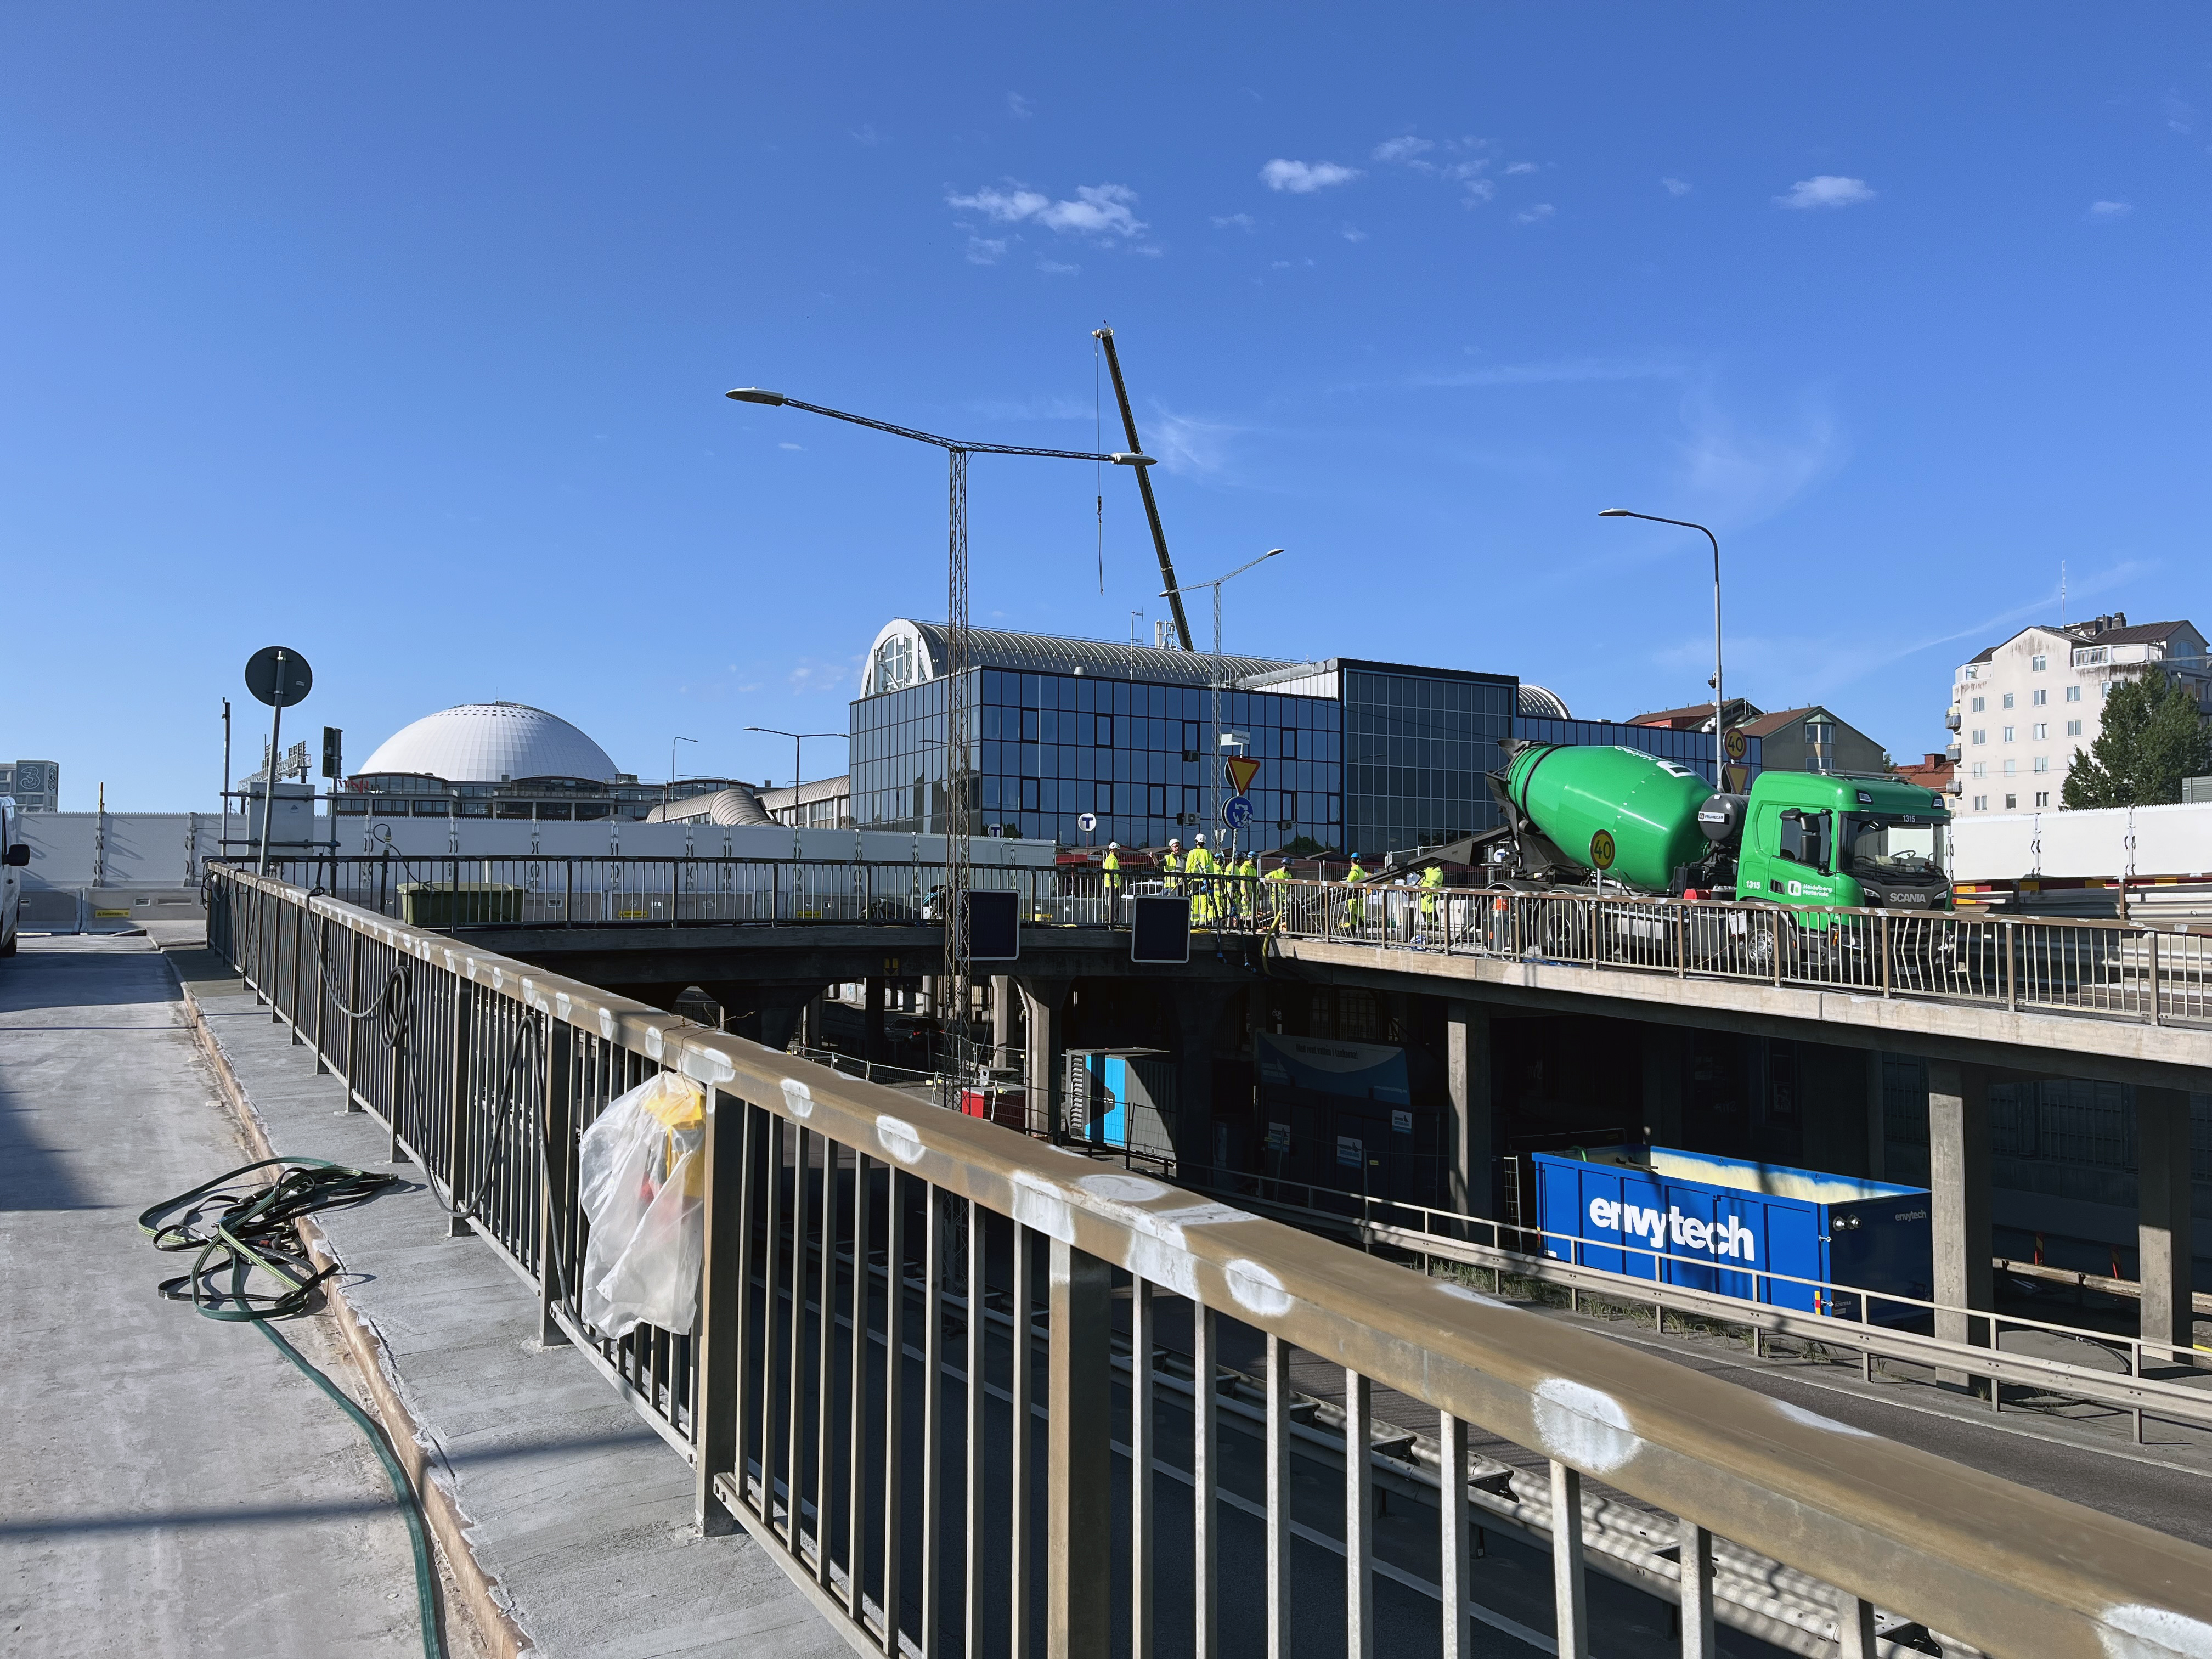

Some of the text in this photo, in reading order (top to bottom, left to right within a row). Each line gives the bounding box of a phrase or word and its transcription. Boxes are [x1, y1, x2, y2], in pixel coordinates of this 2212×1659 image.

[1728, 736, 1743, 752] 40
[20, 766, 41, 789] 3
[1082, 817, 1093, 829] T
[1903, 815, 1916, 823] 1315
[1594, 840, 1612, 860] 40
[1746, 880, 1760, 889] 1315
[1803, 884, 1832, 893] Heidelberg
[1802, 889, 1830, 898] Materials
[1889, 893, 1926, 903] SCANIA
[1895, 1209, 1927, 1222] envytech
[1589, 1198, 1754, 1261] envytech
